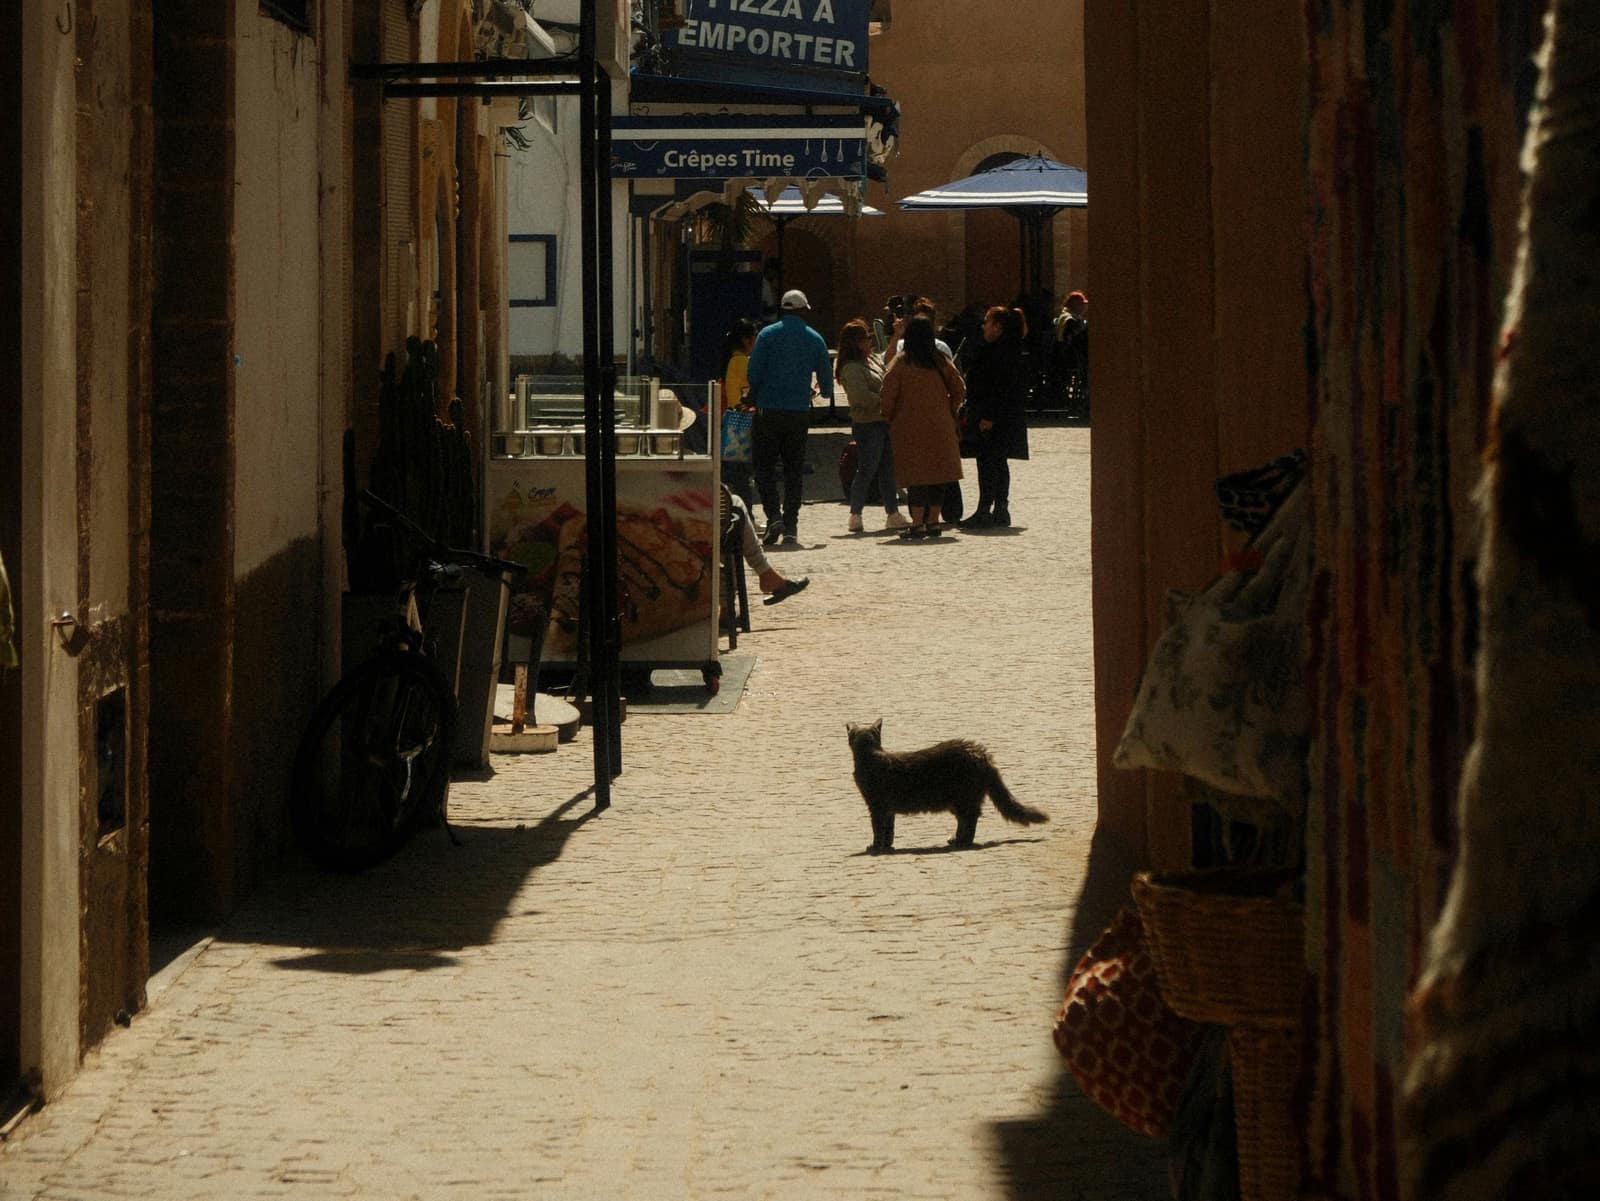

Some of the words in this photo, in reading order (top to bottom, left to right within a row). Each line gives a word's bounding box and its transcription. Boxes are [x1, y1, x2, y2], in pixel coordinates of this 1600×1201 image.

[677, 18, 856, 68] EMPORTER
[664, 149, 738, 171] Crêpes
[742, 149, 795, 168] Time
